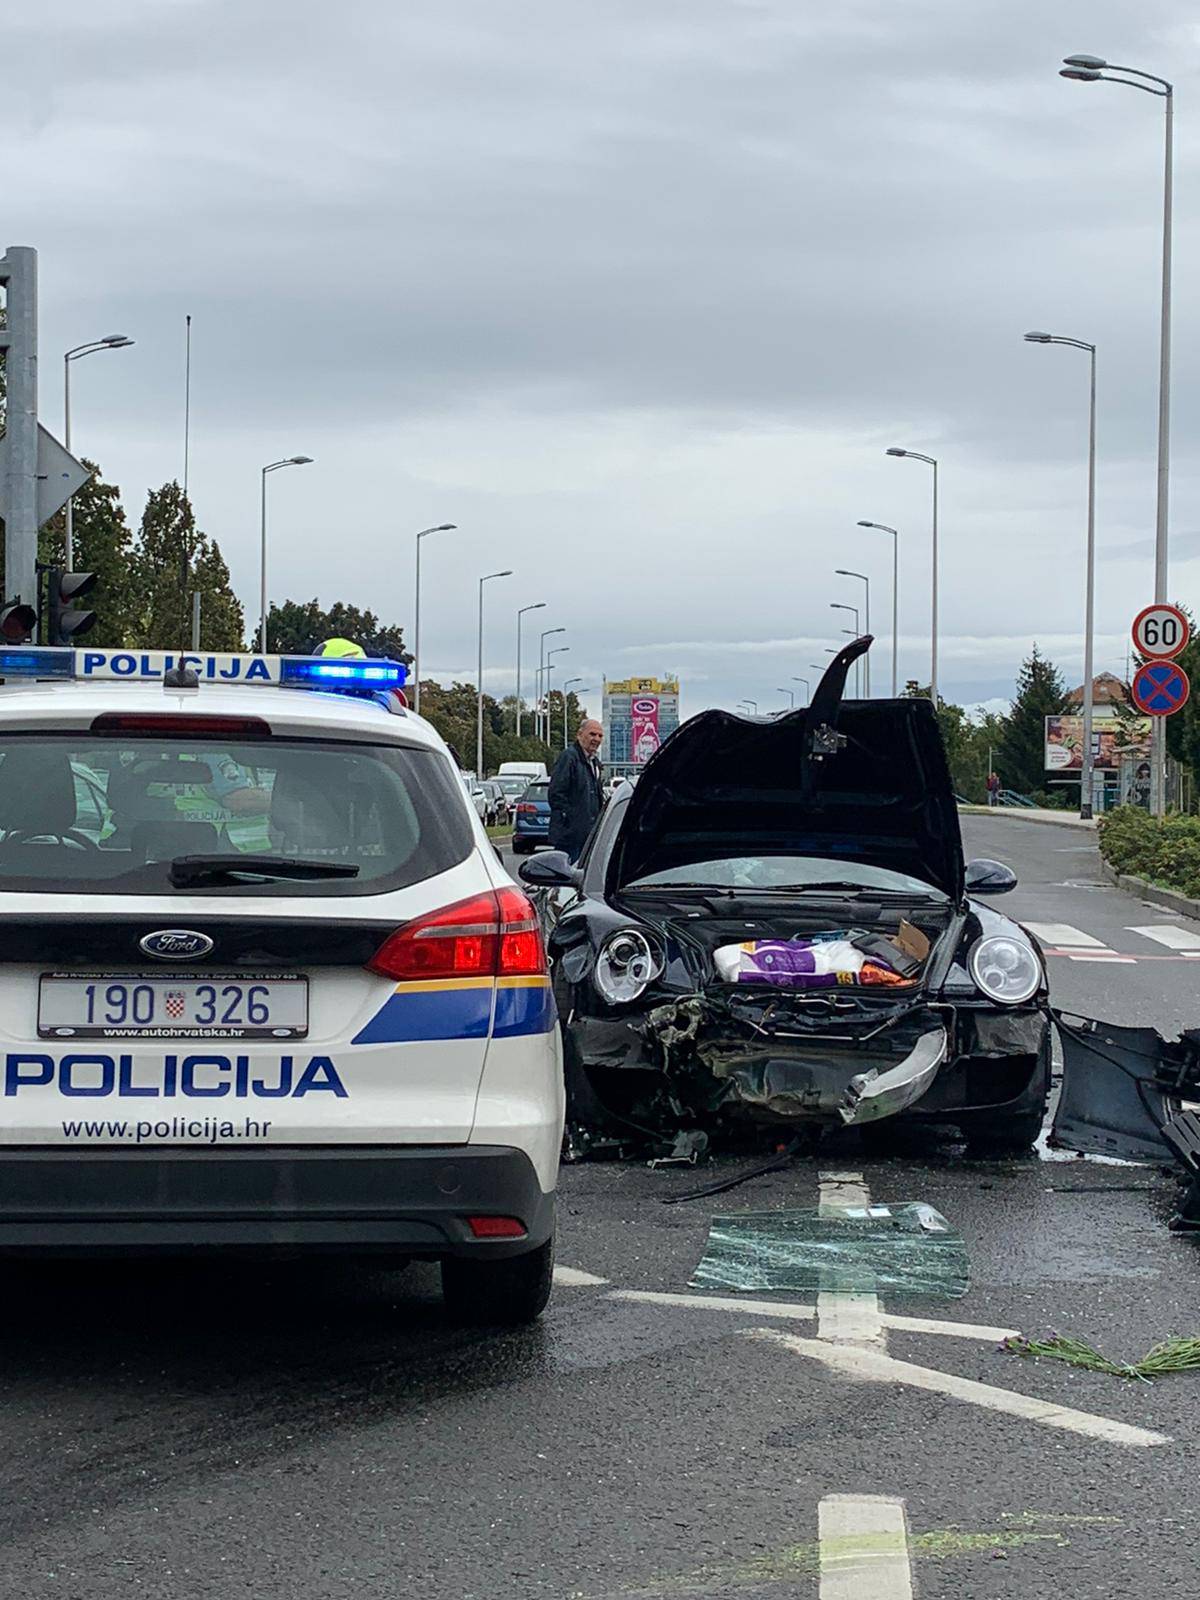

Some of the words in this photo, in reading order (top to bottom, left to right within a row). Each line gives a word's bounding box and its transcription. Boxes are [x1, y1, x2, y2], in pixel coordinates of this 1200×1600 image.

[1144, 618, 1177, 646] 60
[157, 934, 198, 951] Ford
[85, 985, 155, 1024] 190
[195, 985, 270, 1025] 326
[104, 1027, 245, 1038] www.autohrvatska.hr
[4, 1053, 349, 1098] POLICIJA
[62, 1117, 272, 1144] www.policija.hr
